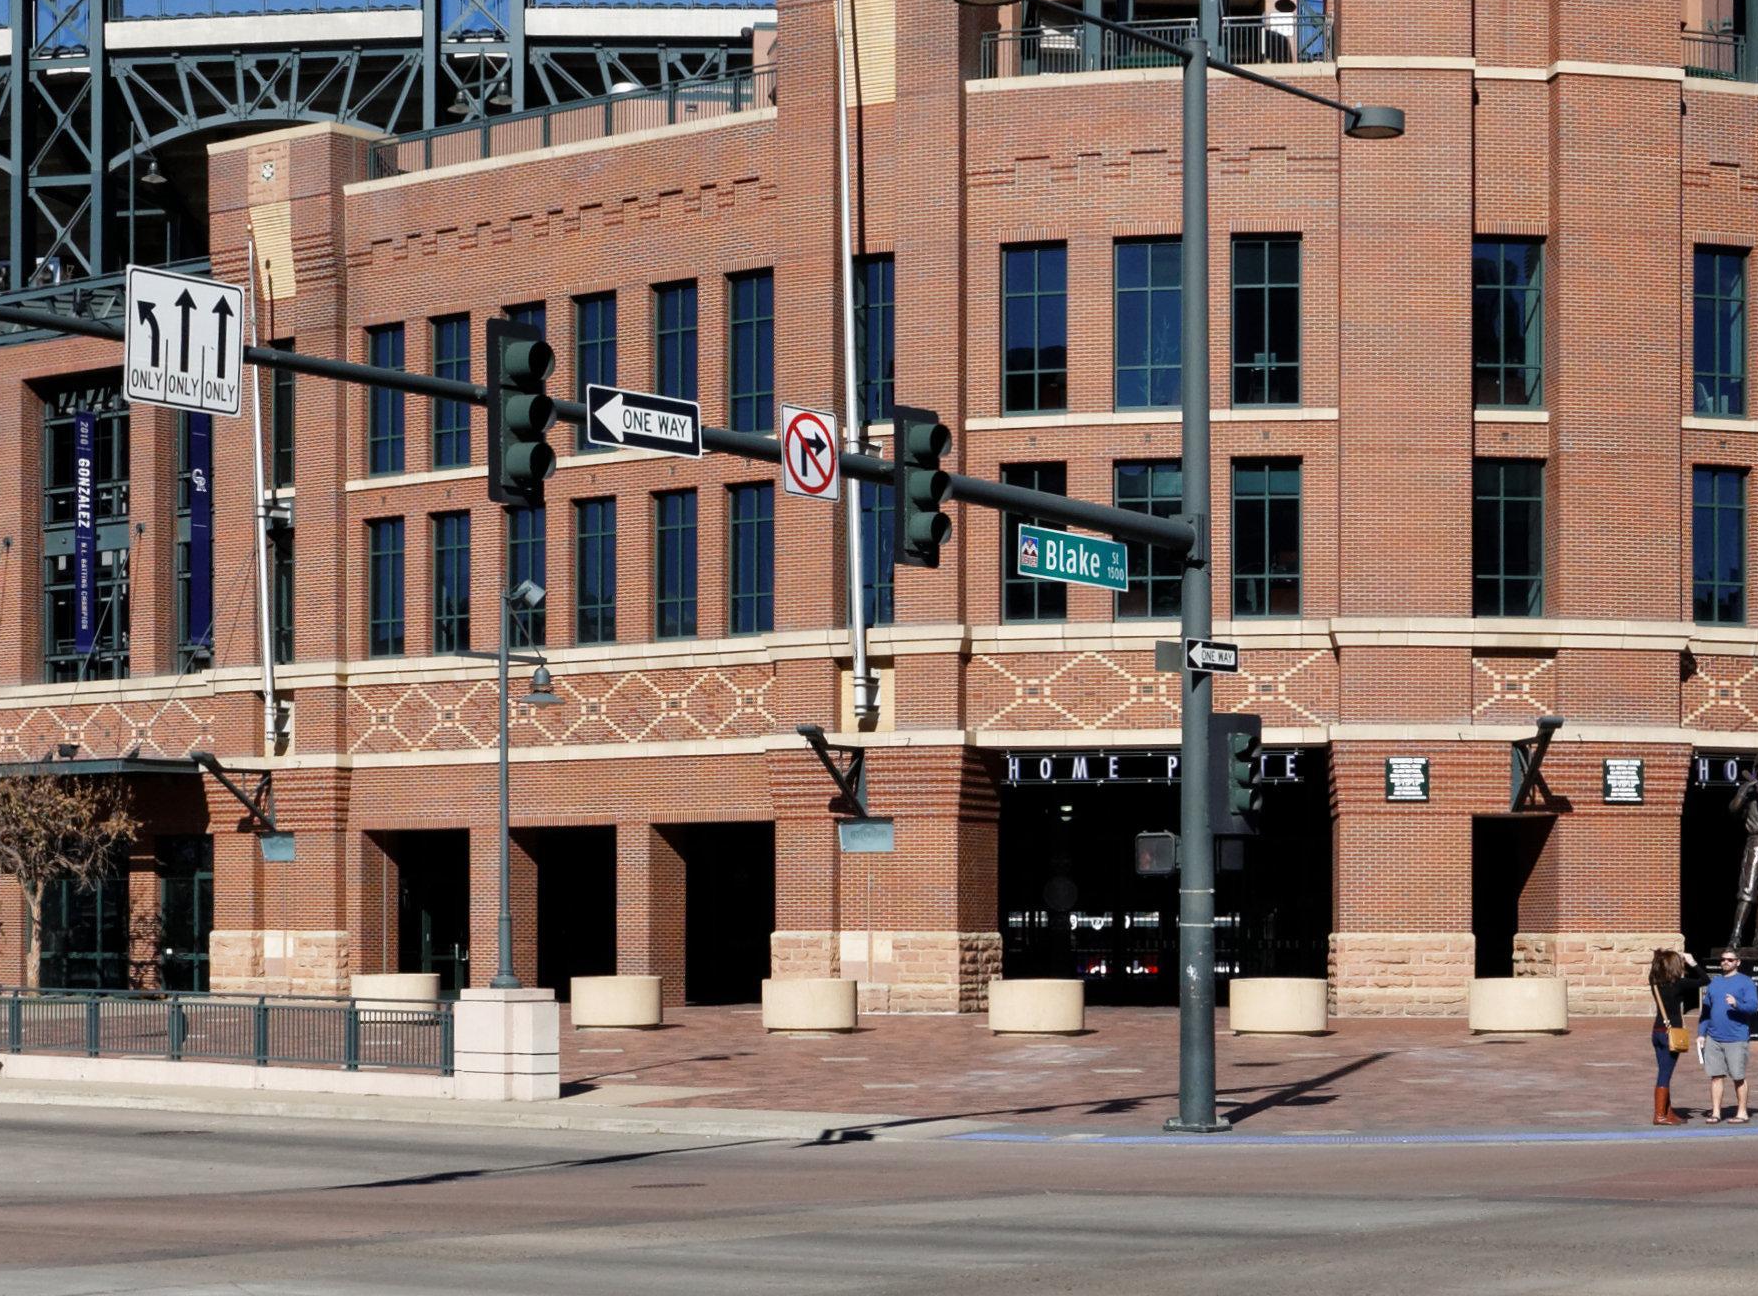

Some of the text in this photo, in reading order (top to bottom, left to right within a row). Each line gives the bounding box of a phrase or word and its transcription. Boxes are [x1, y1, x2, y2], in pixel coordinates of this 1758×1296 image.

[131, 369, 235, 402] ONLY ONLY ONLY
[79, 420, 89, 445] 2010
[623, 409, 687, 438] ONE WAY
[78, 457, 91, 529] GONZALEZ
[1045, 540, 1100, 577] Blake
[1112, 552, 1119, 564] St
[1107, 567, 1124, 581] 1500
[1202, 649, 1233, 664] ONE WAY
[1008, 754, 1296, 779] HOME PTE
